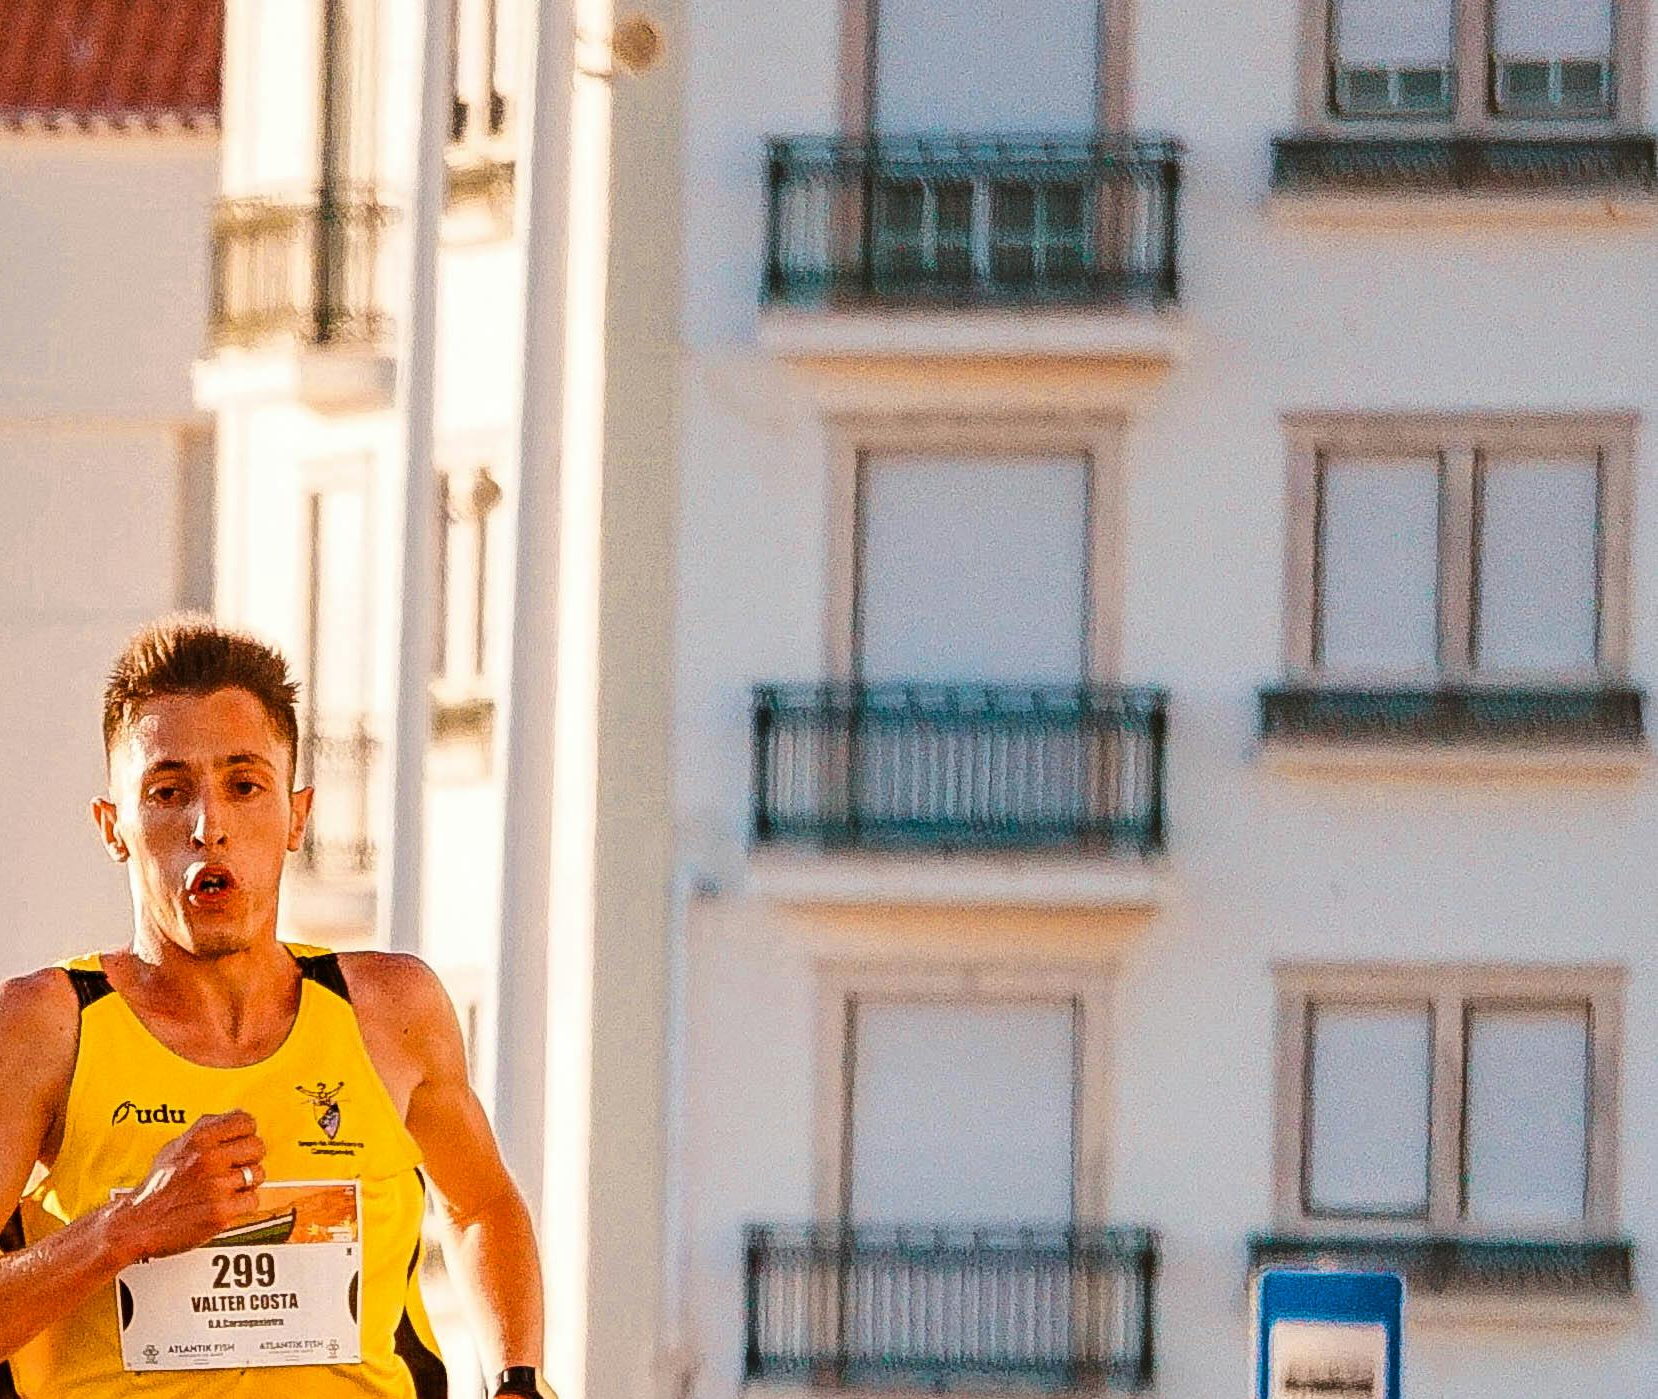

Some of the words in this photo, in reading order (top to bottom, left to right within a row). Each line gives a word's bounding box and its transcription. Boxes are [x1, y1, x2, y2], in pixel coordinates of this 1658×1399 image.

[211, 1252, 275, 1289] 299
[191, 1294, 246, 1313] VALTER
[249, 1292, 299, 1311] COSTA
[168, 1343, 212, 1353] ATLANTIK
[214, 1343, 235, 1352] FISH
[259, 1341, 302, 1350] ATLANTIK
[304, 1340, 323, 1349] FISH
